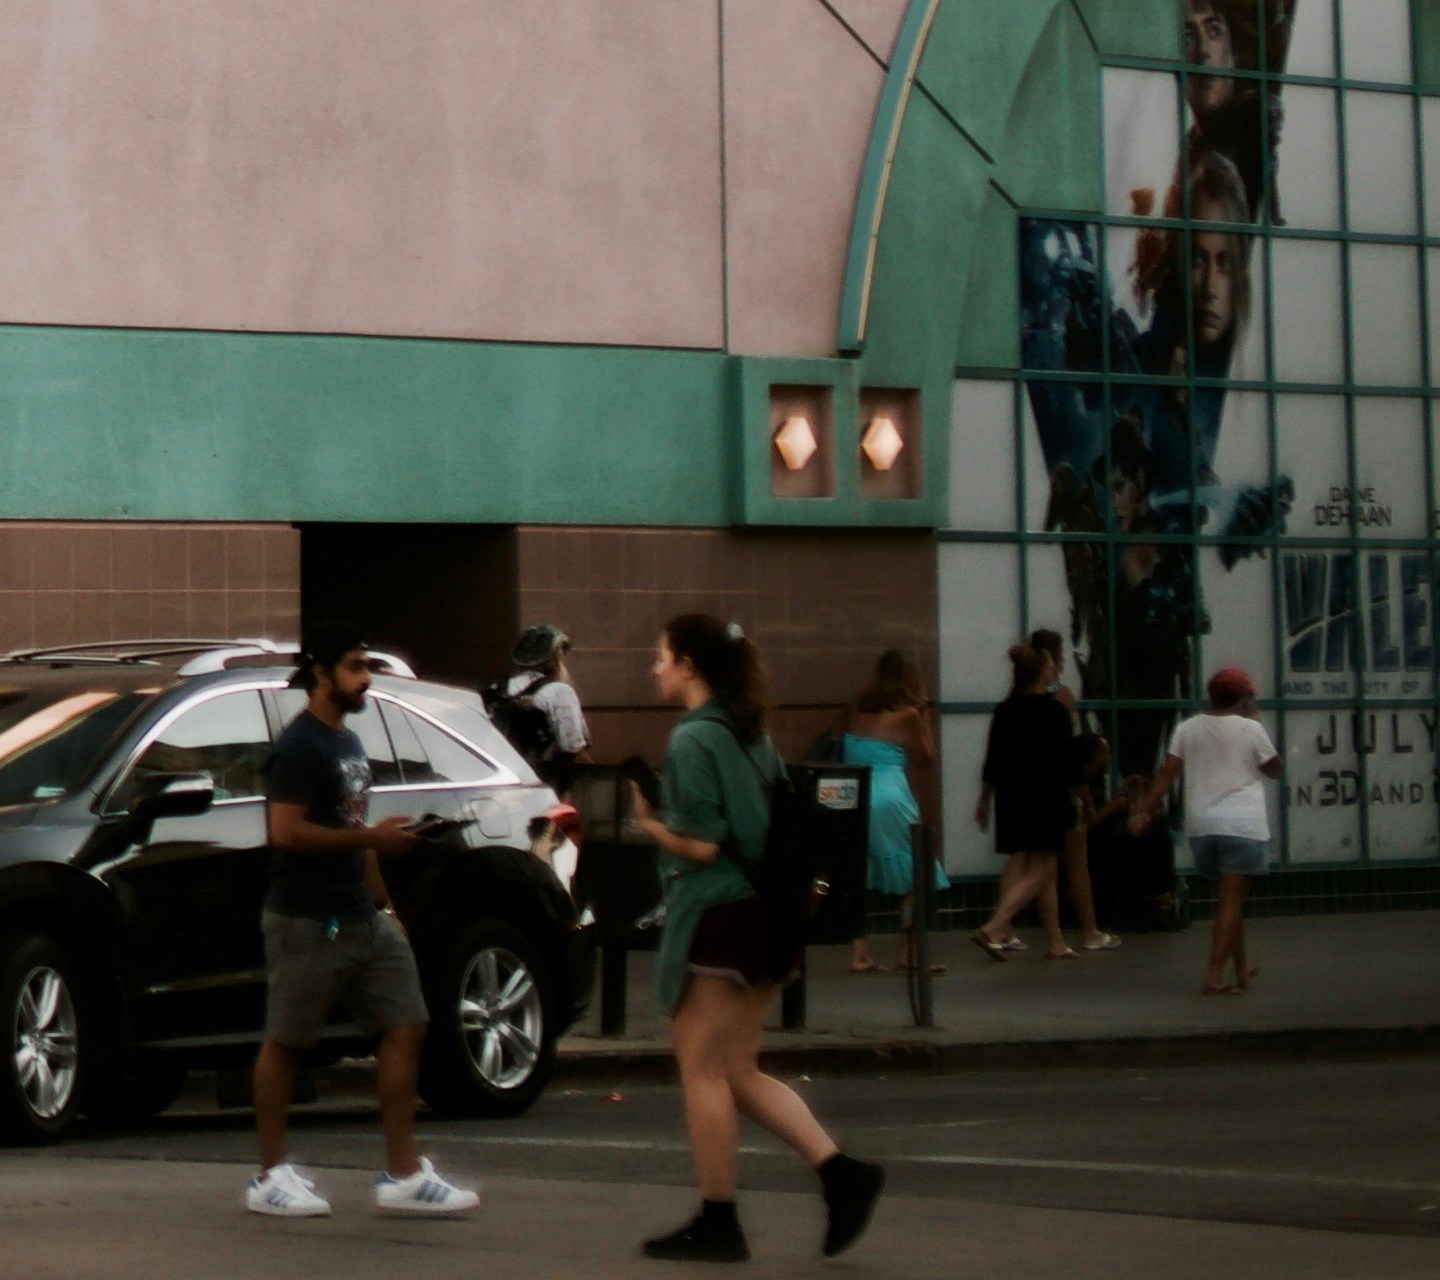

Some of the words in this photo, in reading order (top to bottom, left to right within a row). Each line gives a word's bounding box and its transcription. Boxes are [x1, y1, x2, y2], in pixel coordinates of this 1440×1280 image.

[1316, 714, 1437, 755] JULY
[1318, 771, 1361, 807] 3D
[1370, 782, 1425, 805] AND
